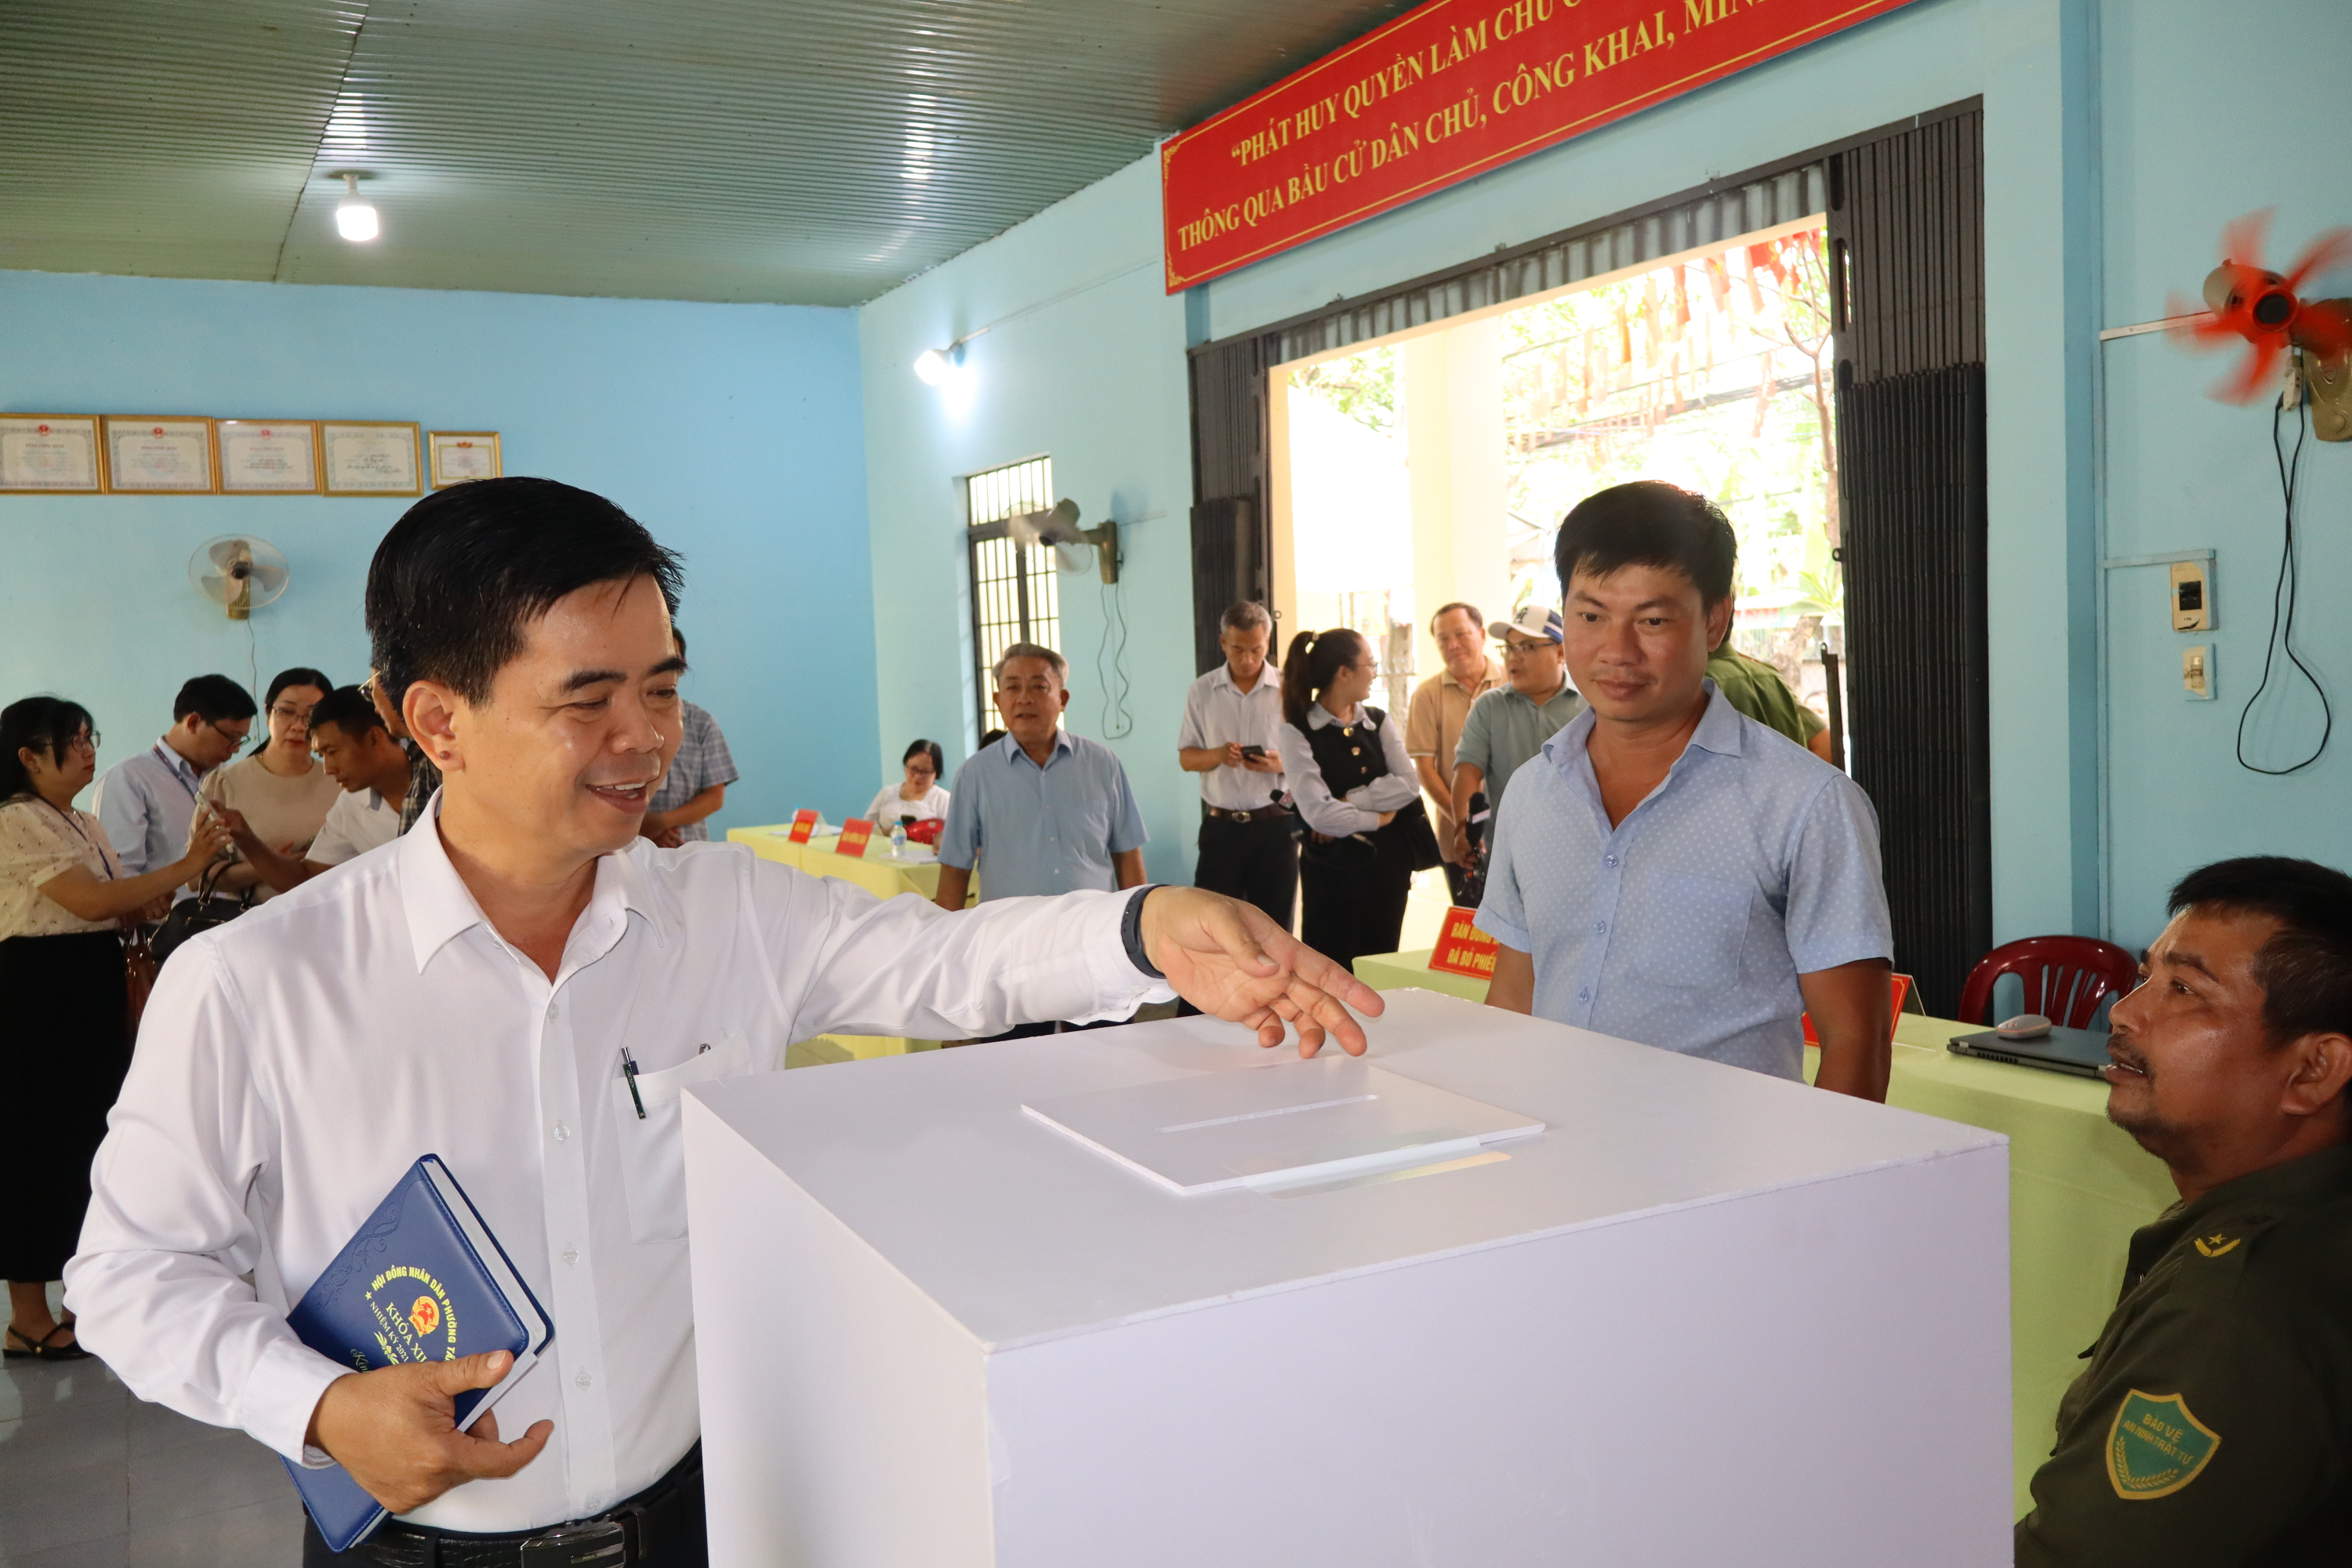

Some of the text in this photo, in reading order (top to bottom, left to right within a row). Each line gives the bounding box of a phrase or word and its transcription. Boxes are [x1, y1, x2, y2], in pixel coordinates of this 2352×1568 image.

[1178, 0, 1765, 252] THÔNG QUA BẦU CỬ DÂN CHỦ, CÔNG KHAI, MI
[1231, 117, 1291, 167] “PHÁT
[1295, 93, 1340, 140] HUY
[1344, 53, 1424, 118] QUYỀN
[1430, 24, 1488, 74] LÀM
[369, 1301, 391, 1333] NHIỆM
[371, 1264, 457, 1362] HỘI ĐỒNG NHÂN DÂN PHƯỜNG TÂ
[385, 1301, 412, 1345] KHÓA
